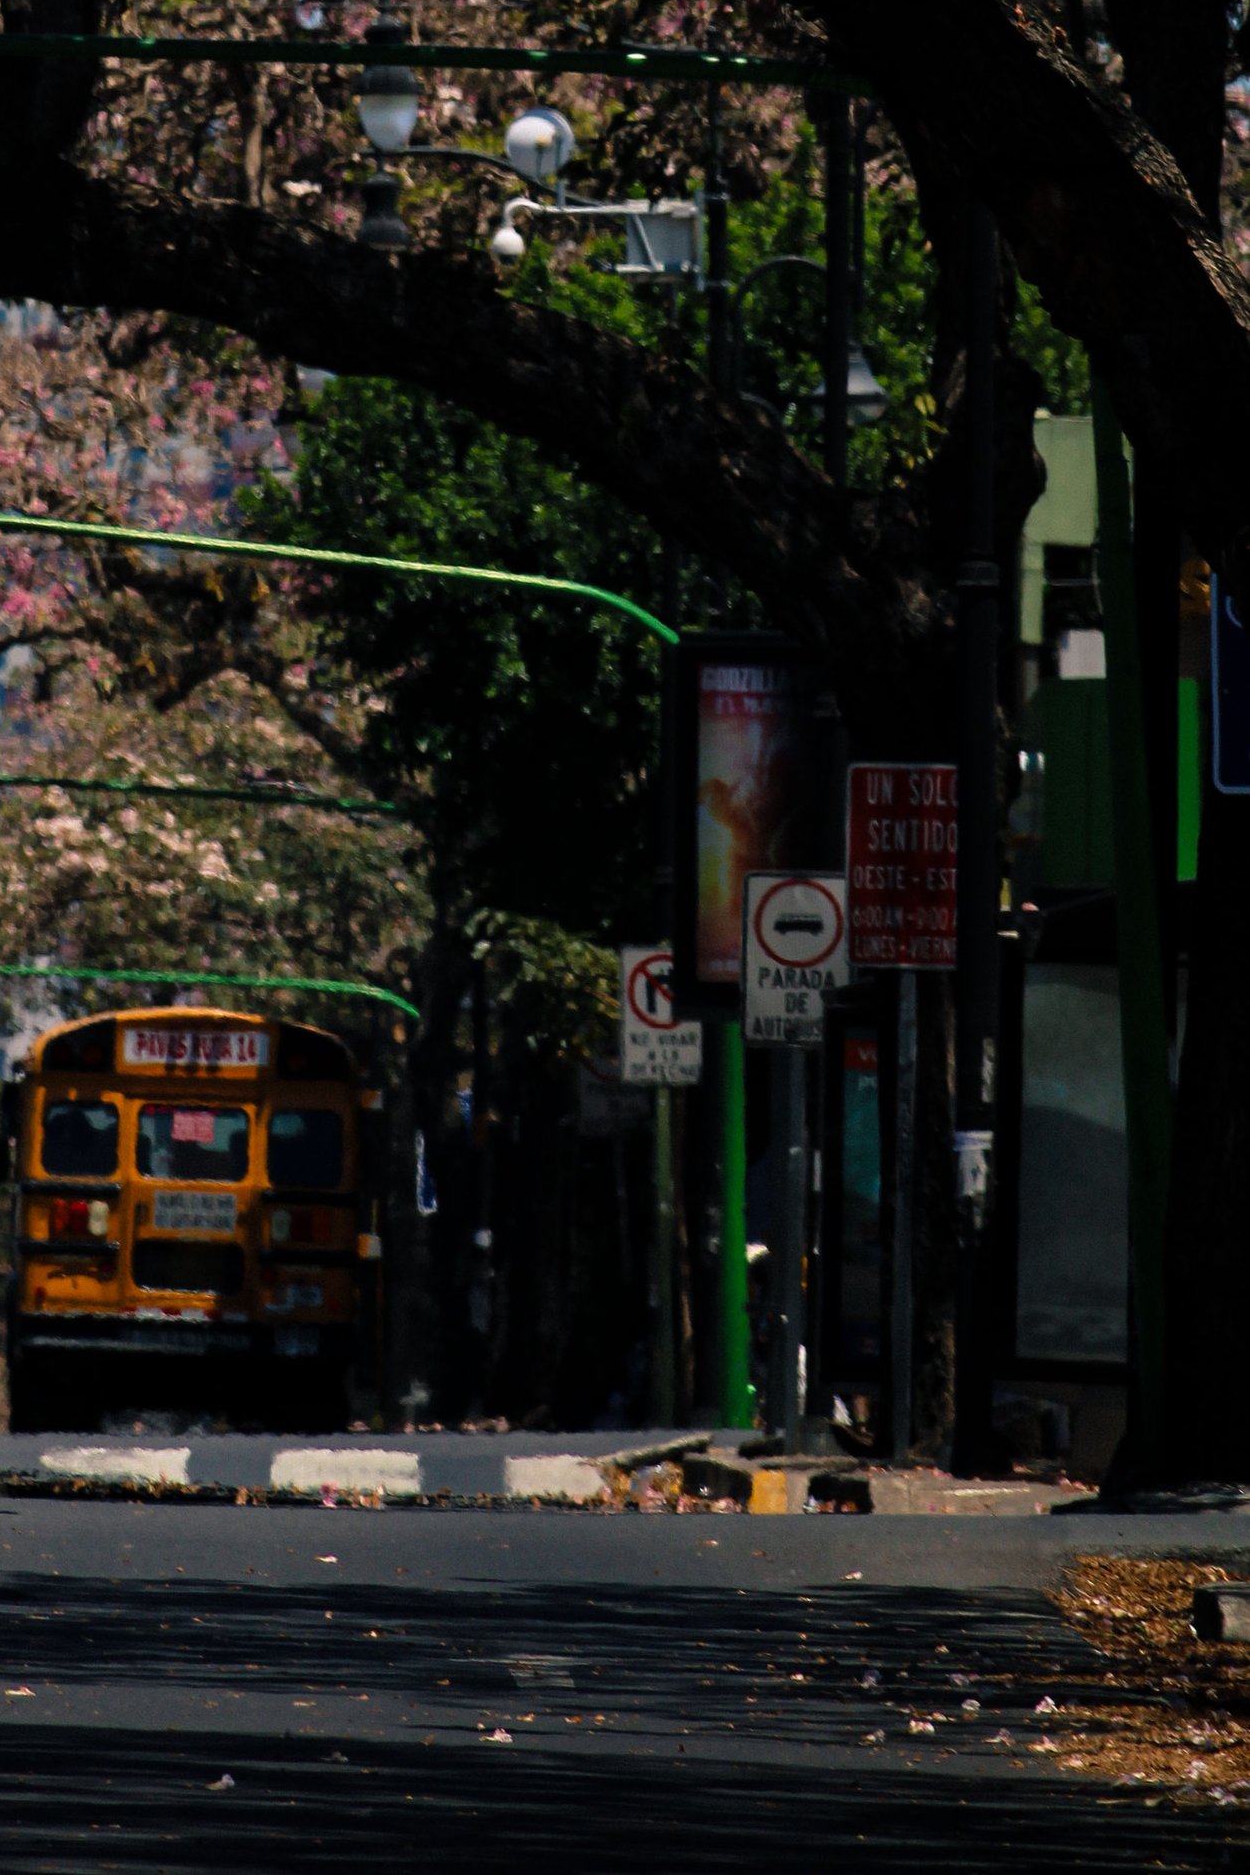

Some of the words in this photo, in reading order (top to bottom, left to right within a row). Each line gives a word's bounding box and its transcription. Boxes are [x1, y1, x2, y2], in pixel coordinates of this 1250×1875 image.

[867, 773, 894, 804] UN
[867, 819, 959, 853] SENTIDO
[852, 864, 906, 890] OESTE
[758, 967, 835, 989] PARADA
[785, 992, 809, 1013] DE
[135, 1030, 188, 1059] PAVS
